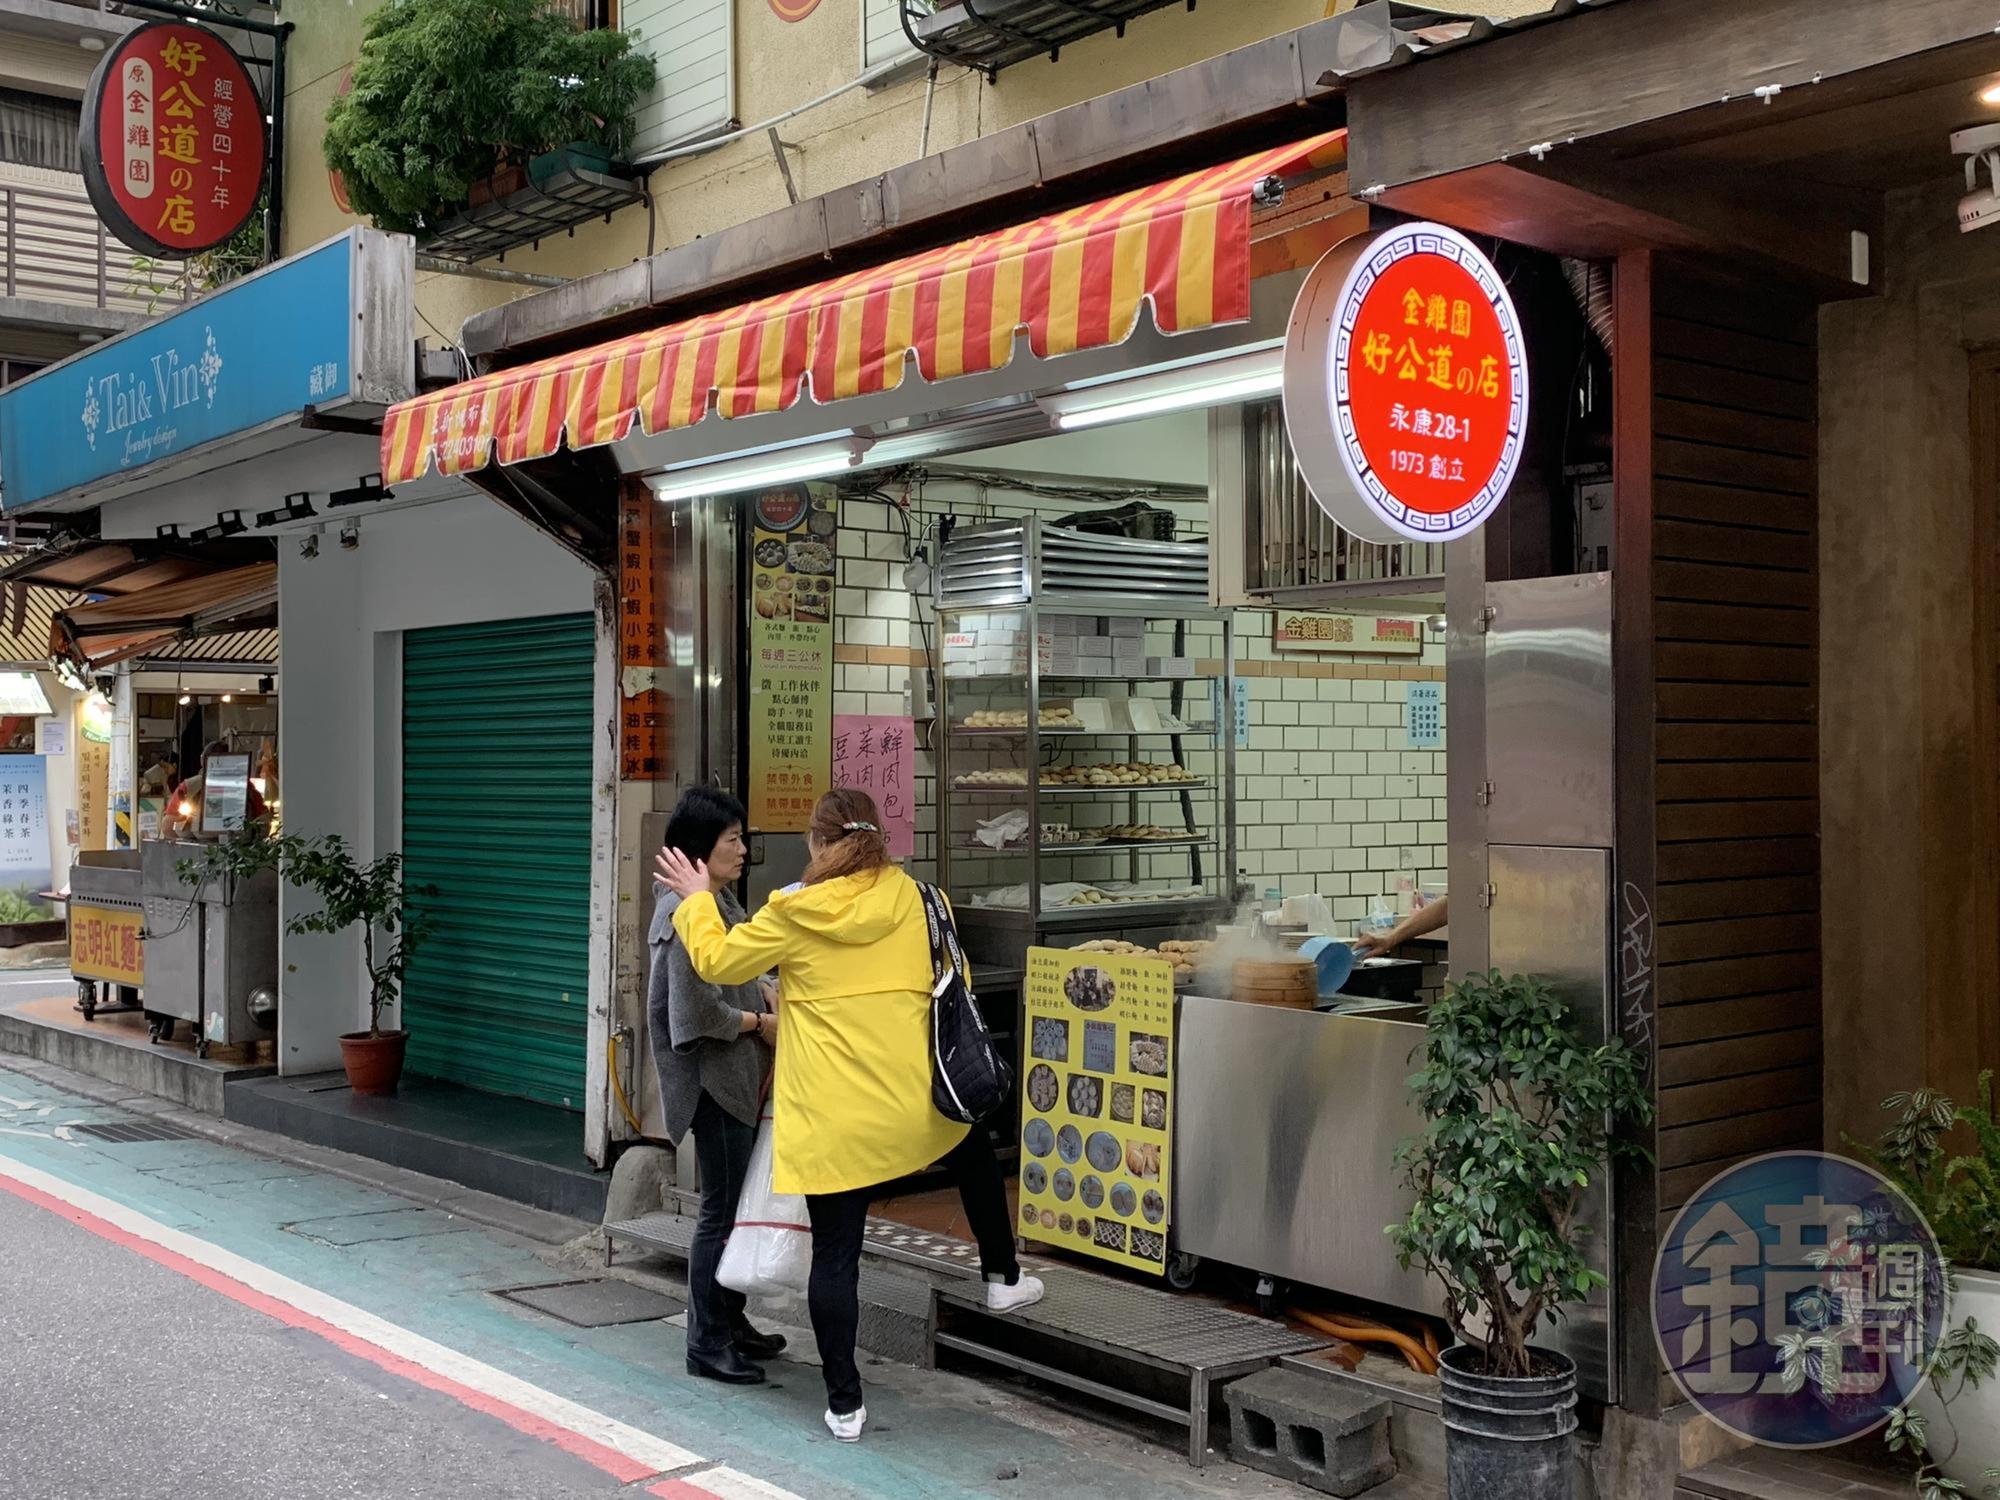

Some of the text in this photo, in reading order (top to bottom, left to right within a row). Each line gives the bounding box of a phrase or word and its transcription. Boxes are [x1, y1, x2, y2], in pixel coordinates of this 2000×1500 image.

[157, 37, 207, 236] 好公道の店
[211, 77, 235, 210] 經營四十年
[1401, 286, 1472, 340] 金雞園
[151, 348, 200, 414] Vin
[1361, 328, 1500, 399] 好公道の店
[153, 425, 177, 450] design
[1388, 402, 1471, 443] 永康28-1
[1390, 449, 1467, 482] 1973 創立
[1284, 616, 1334, 641] 金雞園
[761, 648, 822, 662] 每週三公休
[780, 680, 821, 692] 工作伙伴
[767, 734, 813, 745] 早班工讀生
[768, 720, 813, 732] 全職服務員
[766, 773, 813, 785] 禁帶外食
[880, 726, 905, 819] 鮮肉包
[18, 783, 30, 838] 四季春茶
